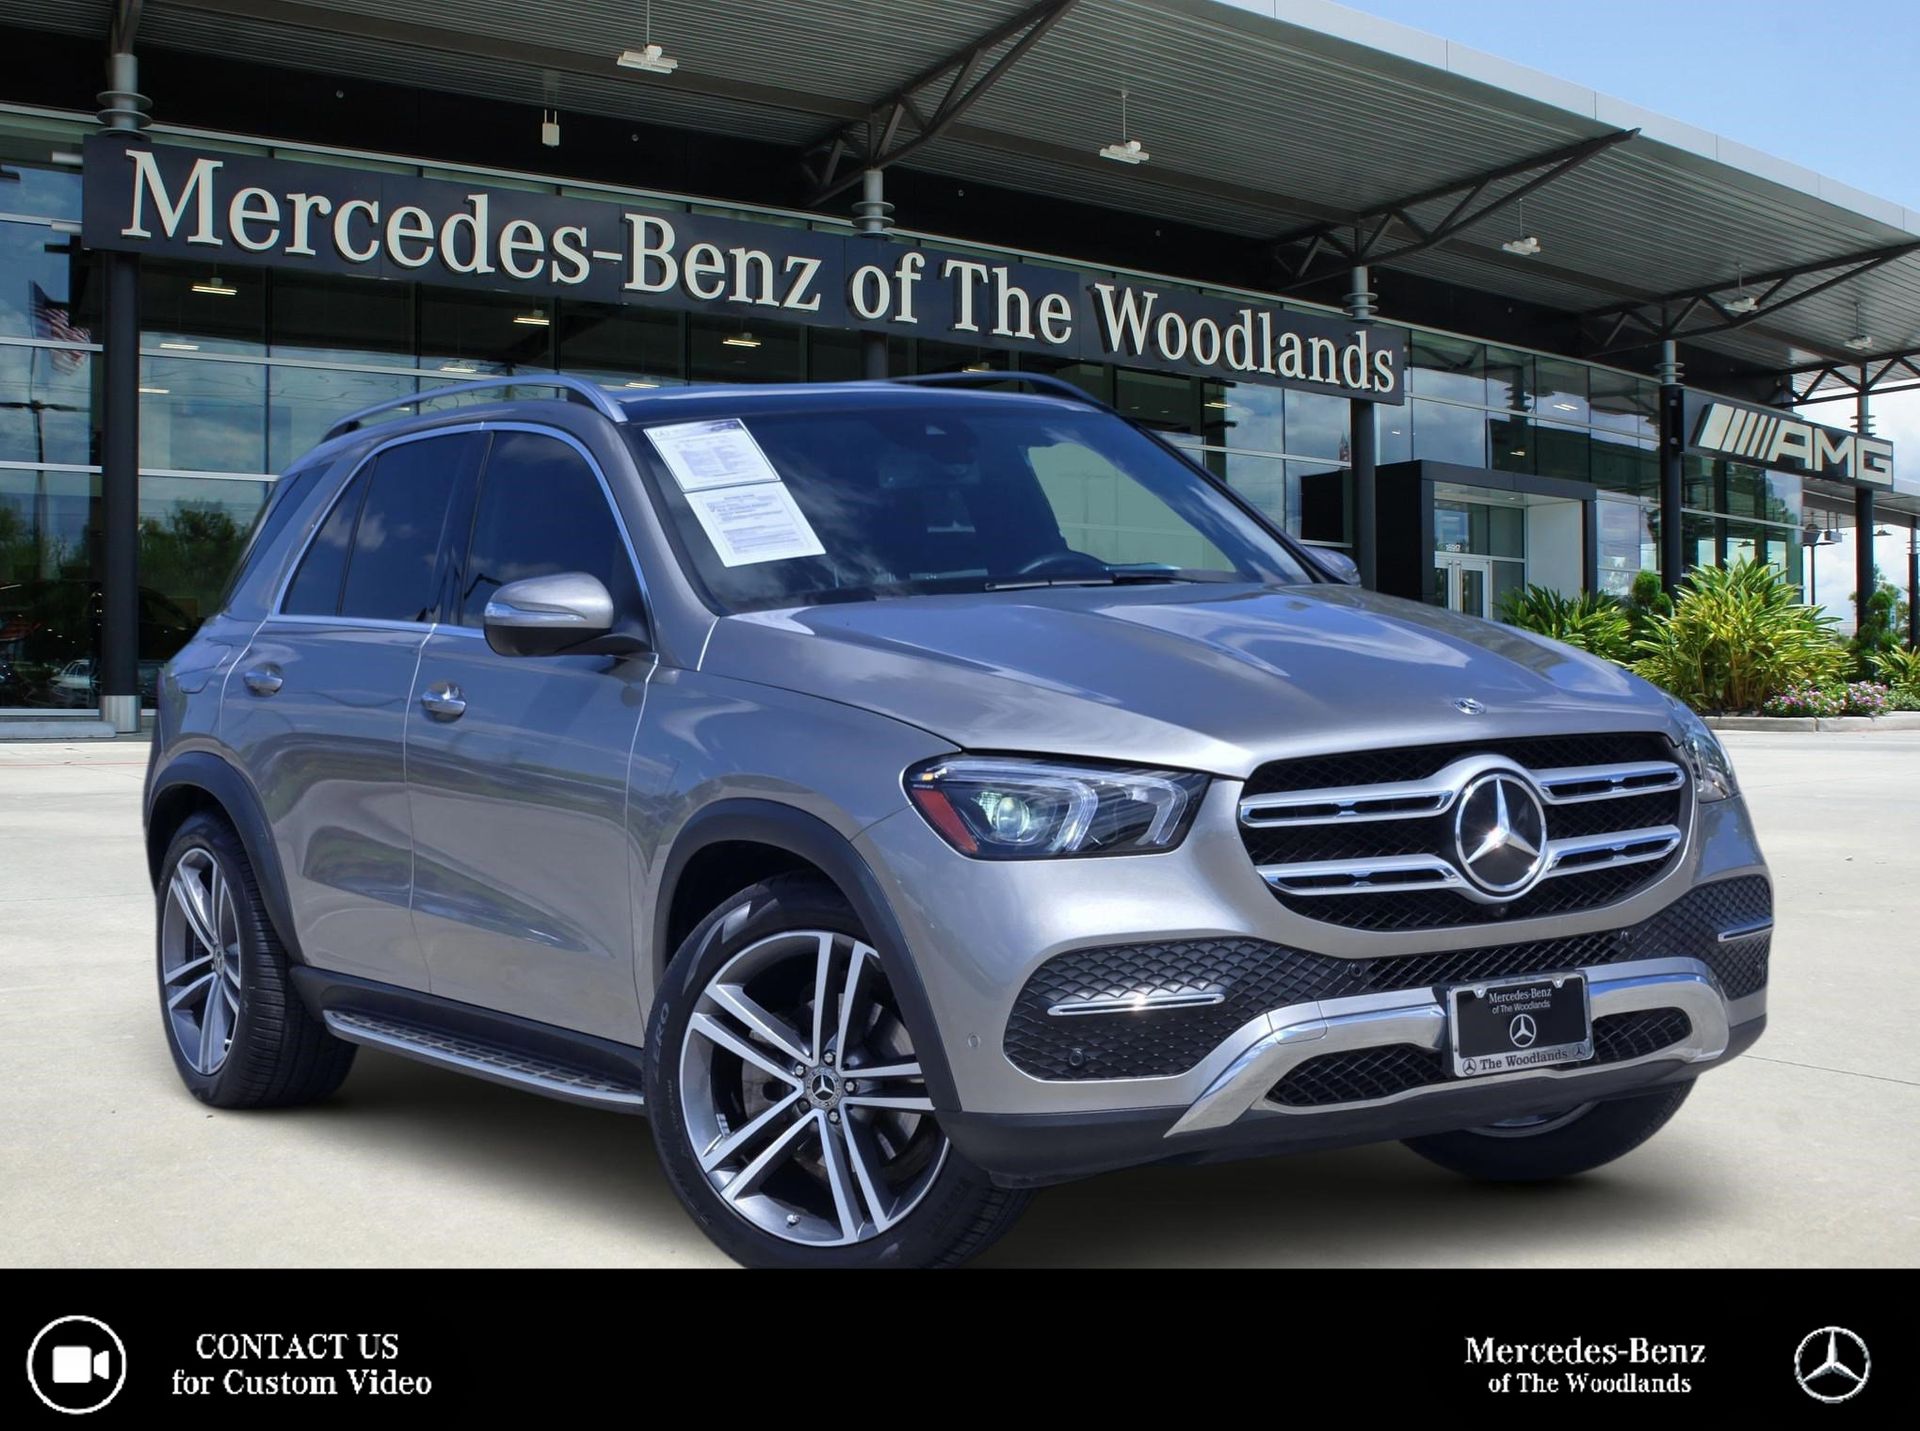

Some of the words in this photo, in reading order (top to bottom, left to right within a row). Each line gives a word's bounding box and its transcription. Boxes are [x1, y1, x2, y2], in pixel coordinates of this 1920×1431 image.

[121, 149, 822, 311] Mercedes-Benz
[851, 252, 925, 323] of
[945, 259, 1073, 344] The
[1094, 282, 1394, 393] Woodlands
[1767, 419, 1893, 486] AMG
[1489, 988, 1552, 1004] Mercedes-Benz
[1492, 1005, 1500, 1015] of
[1501, 1004, 1513, 1013] The
[1513, 1000, 1551, 1011] Woodlands
[1480, 1058, 1502, 1070] The
[1505, 1049, 1568, 1067] Woodlands
